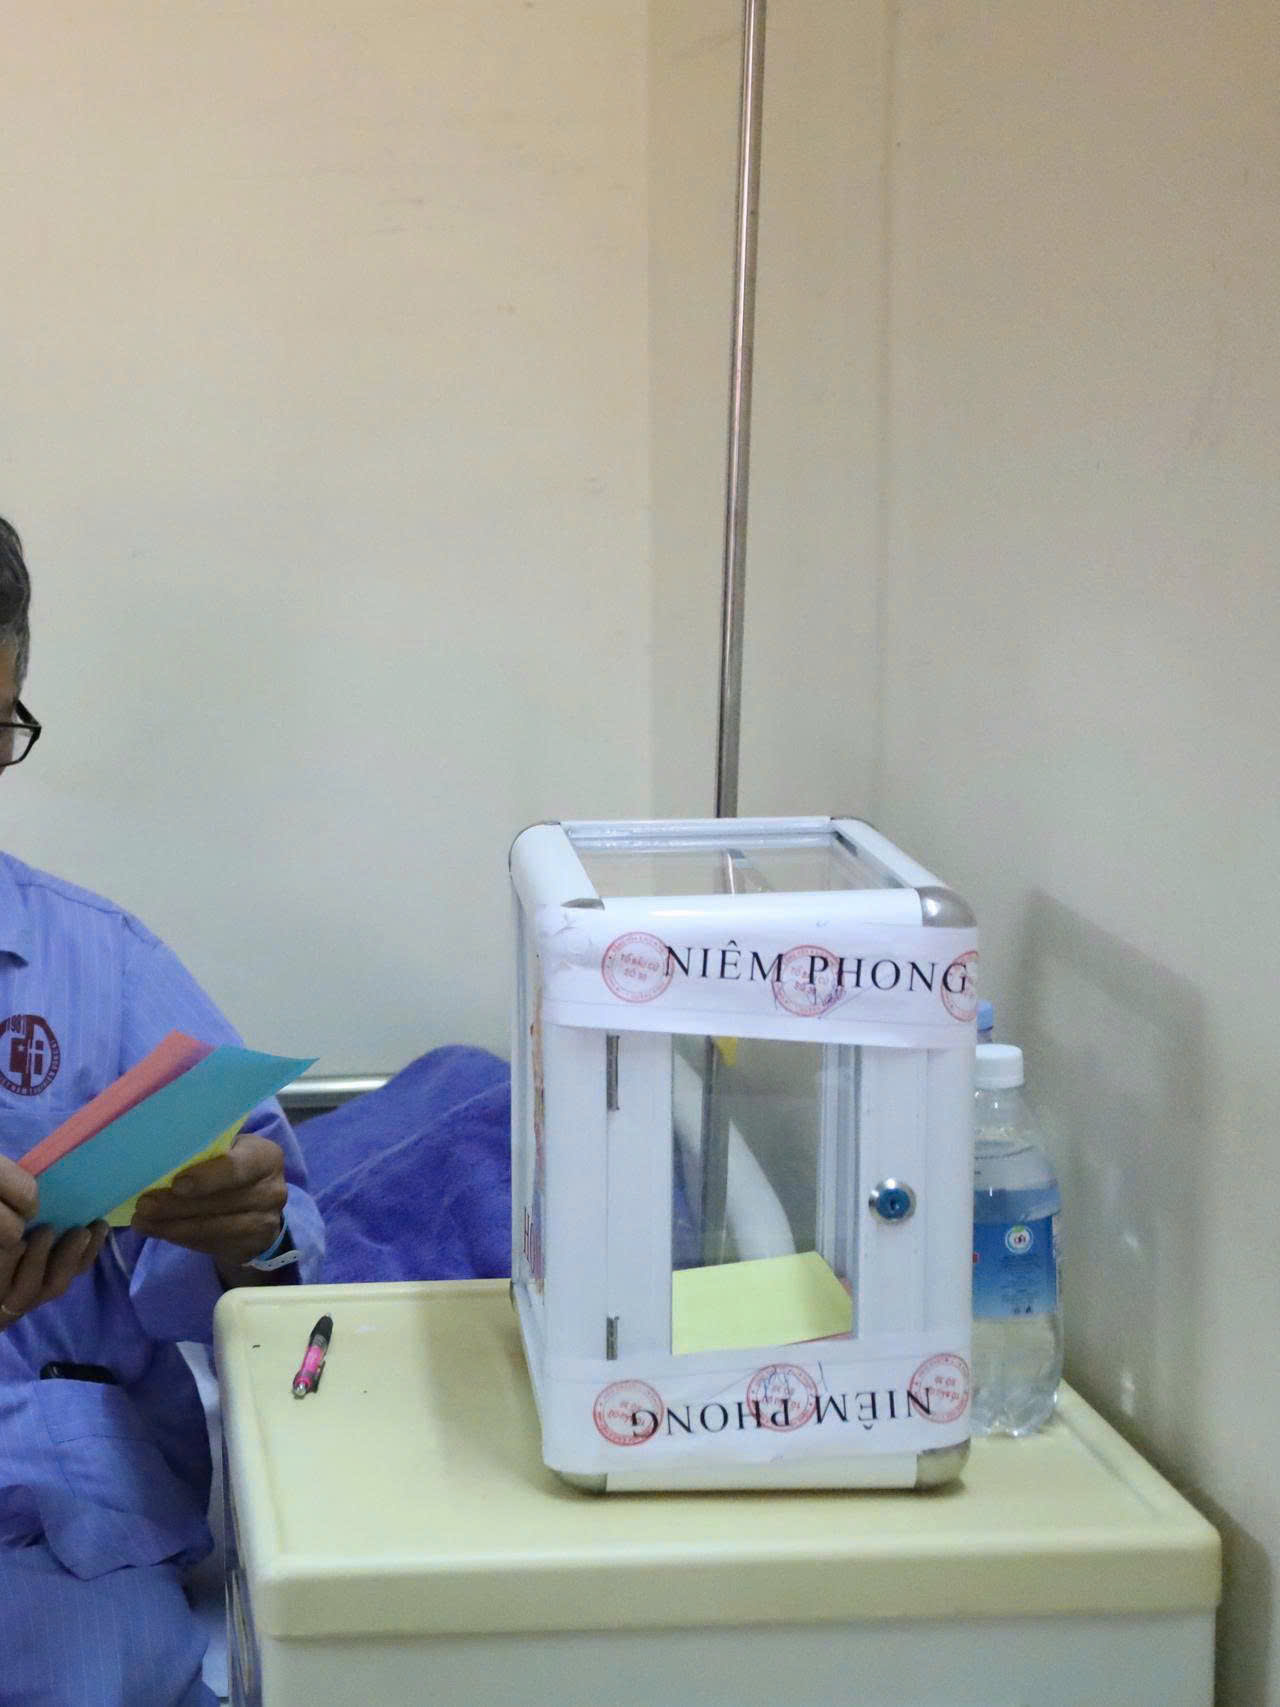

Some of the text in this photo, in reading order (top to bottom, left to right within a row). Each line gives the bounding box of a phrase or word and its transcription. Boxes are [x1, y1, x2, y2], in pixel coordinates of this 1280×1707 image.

[664, 940, 784, 983] NIÊM
[808, 954, 967, 994] PHONG
[631, 1399, 791, 1438] PHONG
[816, 1387, 933, 1431] NIÊM
